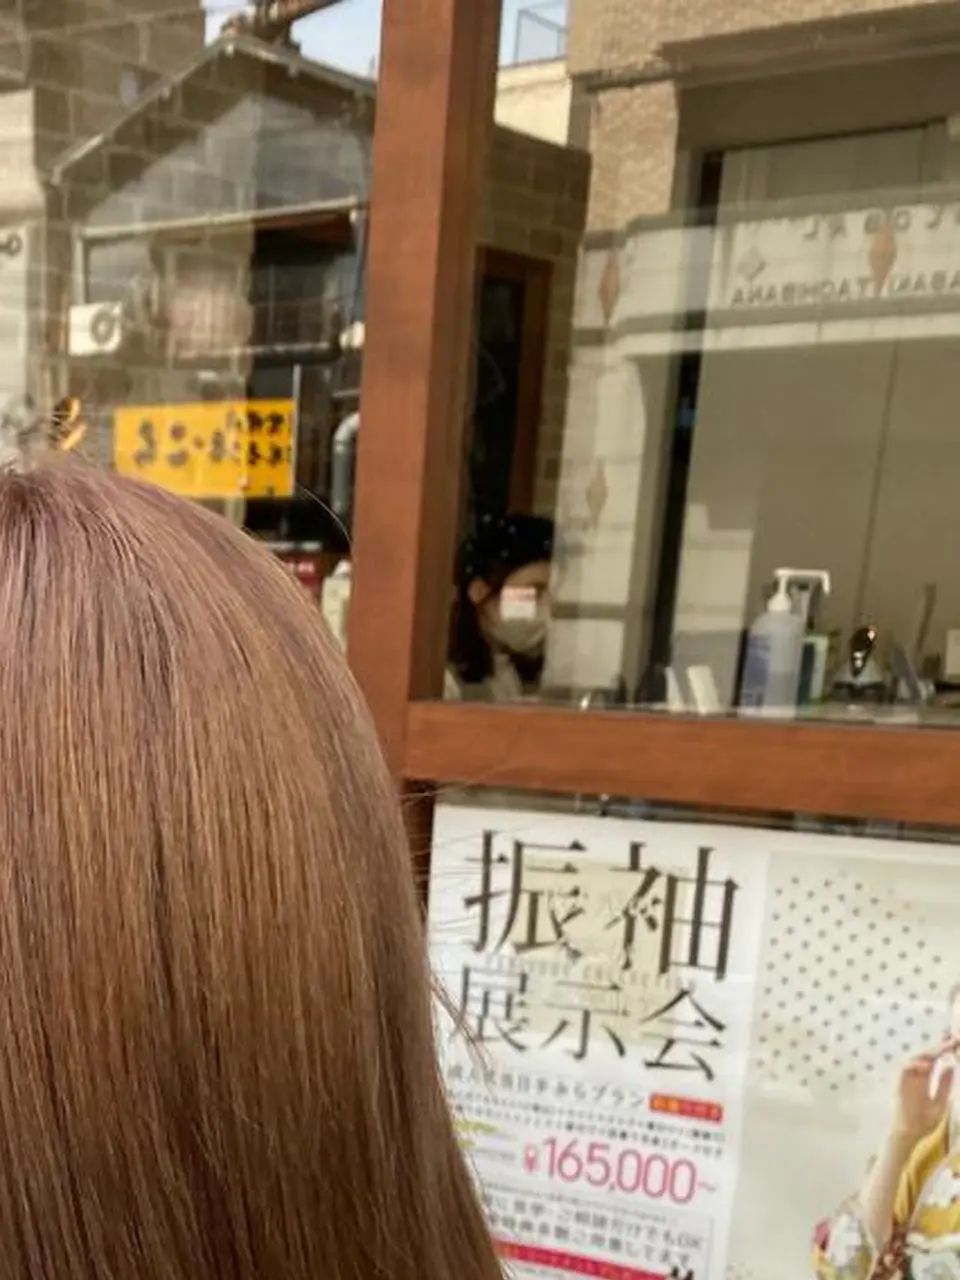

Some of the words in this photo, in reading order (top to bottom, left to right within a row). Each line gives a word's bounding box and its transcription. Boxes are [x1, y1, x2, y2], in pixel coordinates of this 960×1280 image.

[464, 830, 740, 980] 振袖
[449, 965, 728, 1082] 展示会
